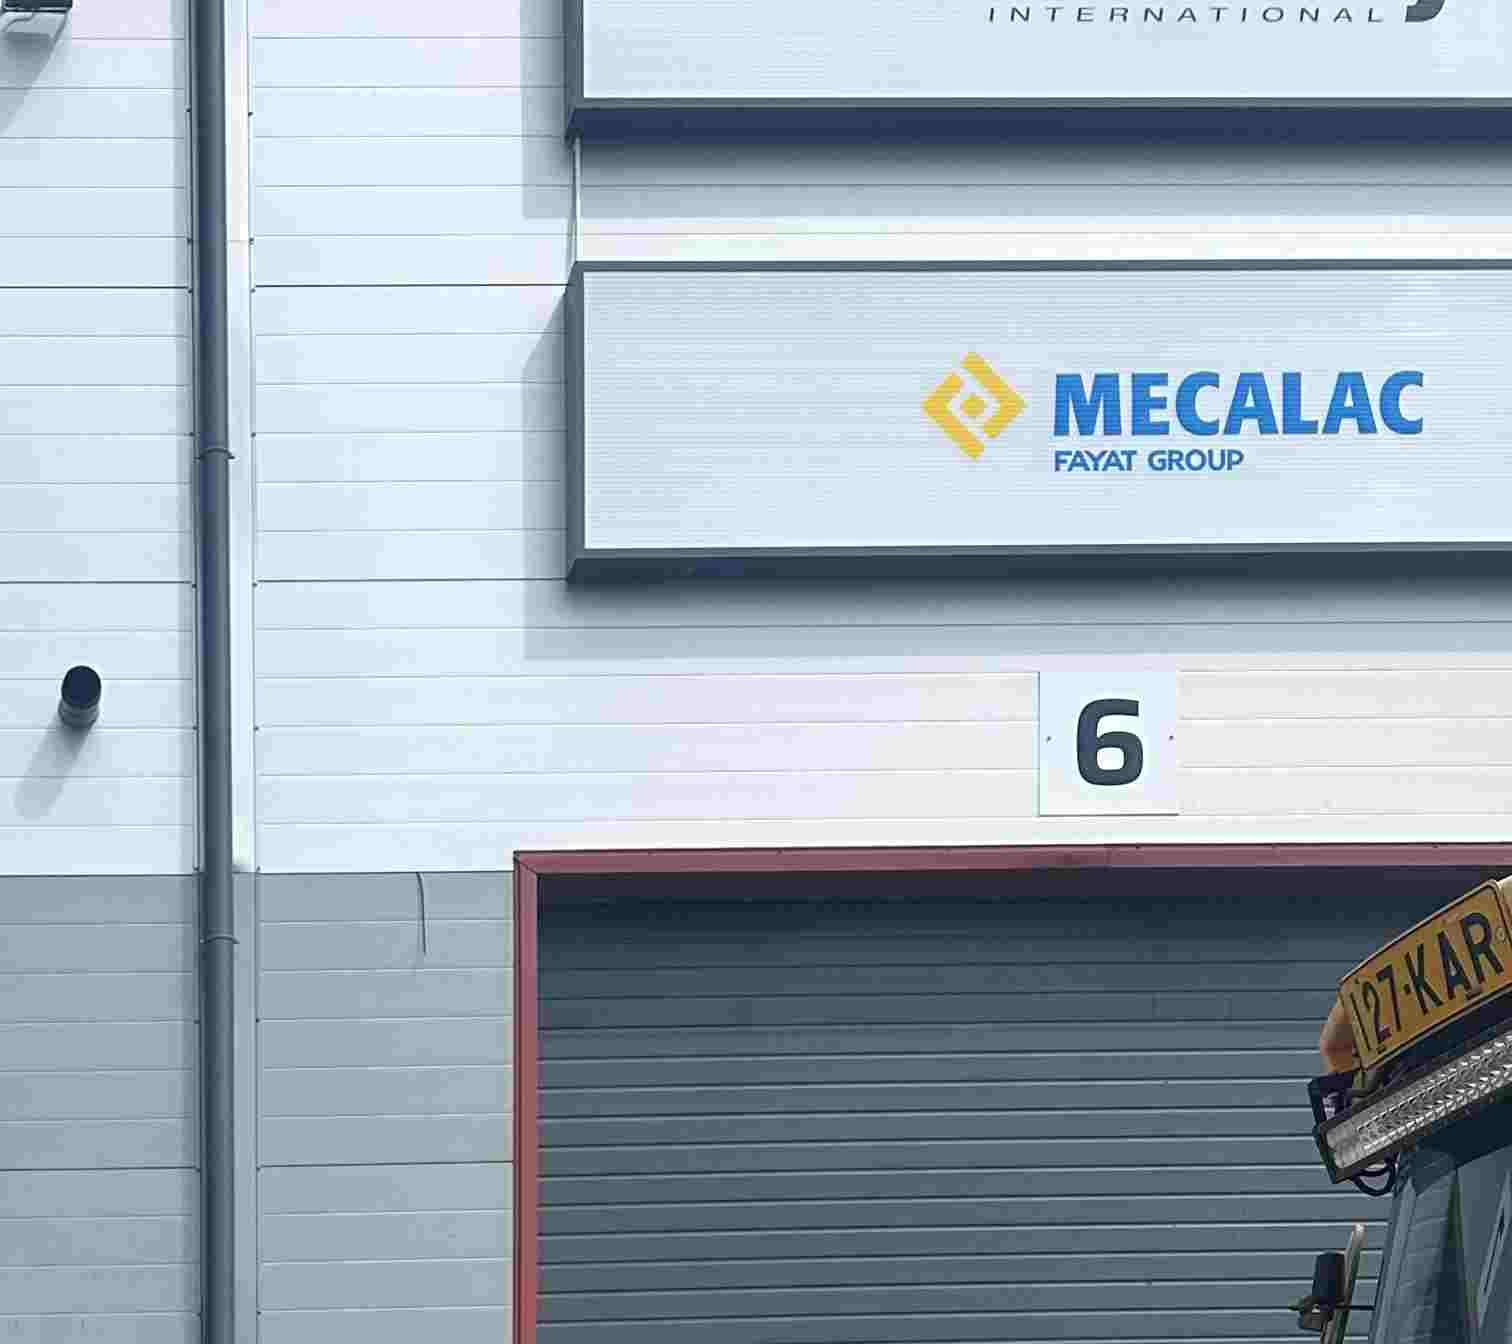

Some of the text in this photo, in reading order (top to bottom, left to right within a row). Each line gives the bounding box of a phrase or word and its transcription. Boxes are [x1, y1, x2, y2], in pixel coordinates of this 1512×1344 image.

[986, 6, 1385, 23] INTERNATIONAL
[1052, 370, 1425, 437] MECALAC
[1053, 448, 1244, 473] FAYAT GROUP
[1075, 698, 1144, 787] 6
